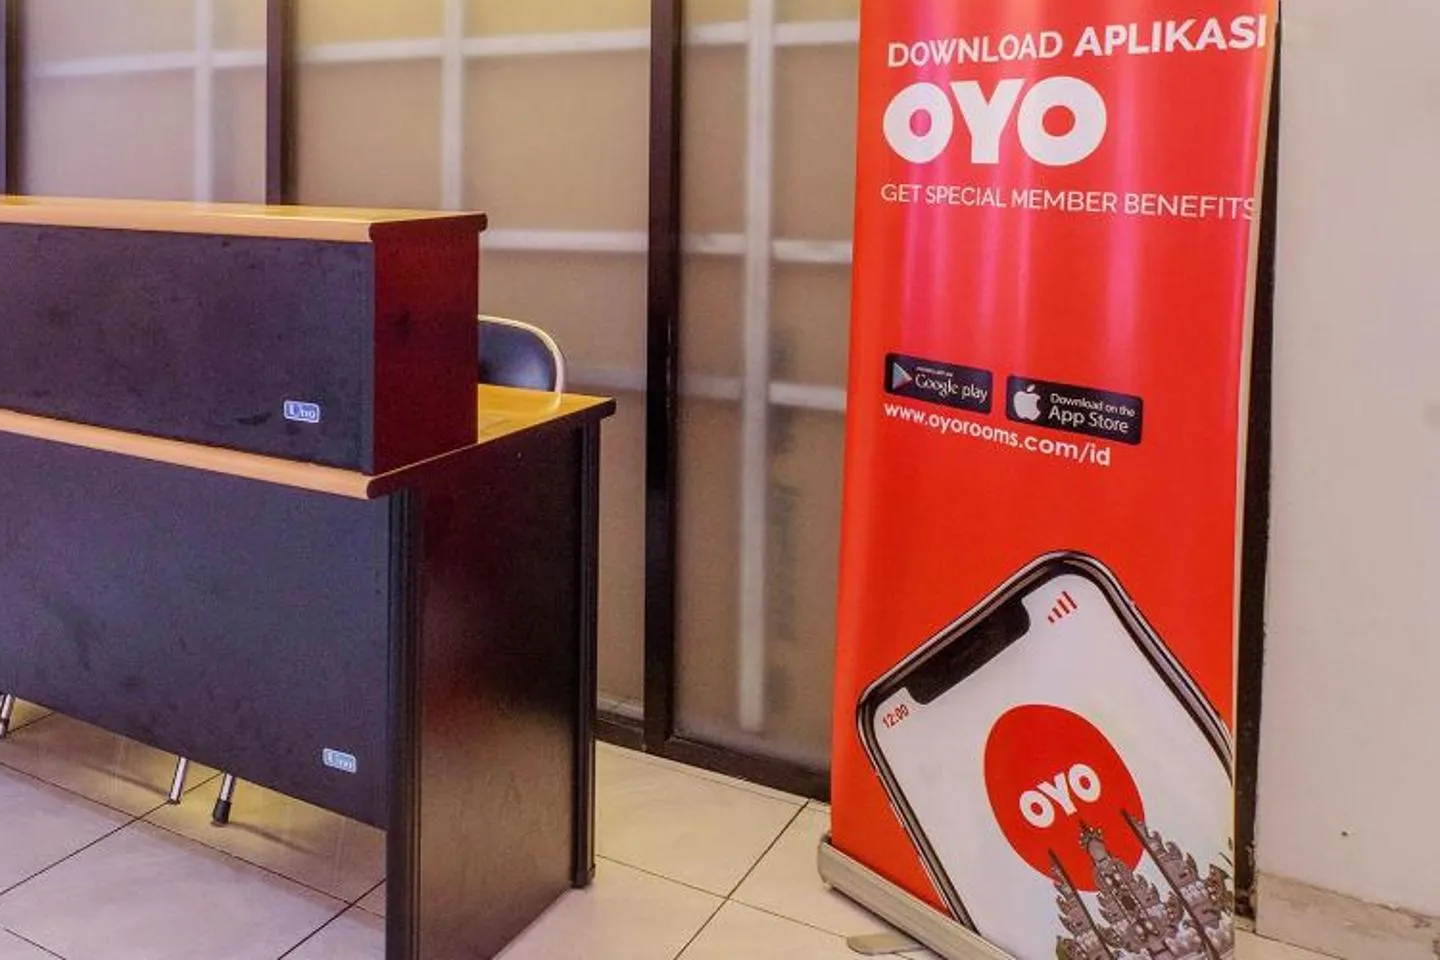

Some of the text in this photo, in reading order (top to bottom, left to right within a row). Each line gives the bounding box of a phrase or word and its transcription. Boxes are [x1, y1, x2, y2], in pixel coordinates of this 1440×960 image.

[887, 14, 1267, 68] DOWNLOAD APLIKASI
[883, 76, 1107, 166] OYO
[880, 183, 1257, 221] GET SPECIAL MEMBER BENEFITS
[915, 373, 988, 403] Google play
[1049, 392, 1135, 418] Download on the
[884, 402, 1111, 467] www.oyorooms.com/id
[1048, 404, 1129, 433] App Store
[881, 703, 910, 730] 12:00
[1018, 763, 1102, 829] OYO
